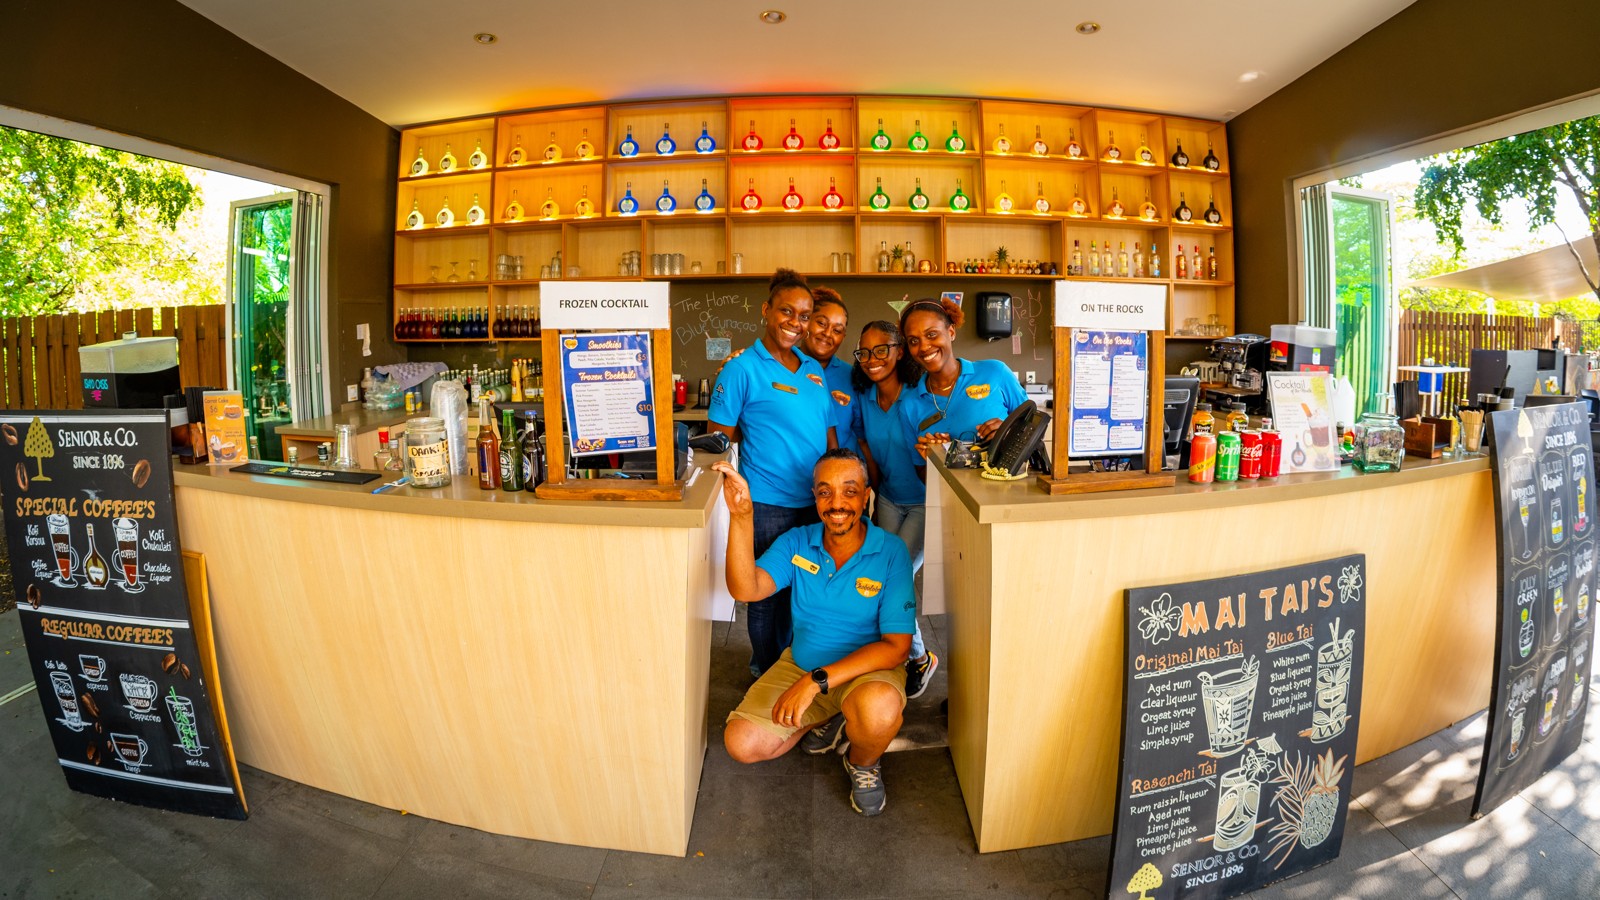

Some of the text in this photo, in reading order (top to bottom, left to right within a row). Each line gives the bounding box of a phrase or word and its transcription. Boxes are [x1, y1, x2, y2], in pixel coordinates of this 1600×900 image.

[559, 299, 649, 309] FROZEN COCKTAIL
[674, 291, 741, 312] The Home
[1081, 304, 1144, 314] ON THE ROCKS
[676, 321, 706, 345] Blue
[1114, 336, 1132, 346] Rocks
[588, 340, 622, 350] Smoothies
[578, 370, 636, 381] Frozen Cocktails
[1274, 380, 1306, 389] Cocktail
[58, 427, 138, 447] SENIOR & CO.
[1545, 434, 1564, 449] SINCE
[73, 454, 124, 470] SINCE 1896
[16, 497, 155, 519] SPECIAL COFFEE'S
[149, 529, 164, 541] Kofi
[144, 562, 171, 573] Chocolate
[1519, 574, 1536, 594] JOLLY
[1178, 575, 1334, 637] MAI TAI'S
[1517, 588, 1538, 606] GREEN
[41, 618, 174, 645] REGULAR COFFEE'S
[1266, 624, 1314, 649] Blue Tai
[1135, 638, 1243, 672] Original Mai Tai
[1272, 652, 1310, 670] White rum
[1270, 664, 1312, 683] Blue liqueur
[1147, 679, 1192, 695] Aged rum
[1269, 677, 1312, 697] Orgeat syrup
[1140, 692, 1197, 710] Clear liqueur
[1272, 690, 1307, 708] Lime juice
[1141, 706, 1196, 725] Orgeat syrup
[1262, 700, 1313, 722] Pineapple juice
[1146, 719, 1190, 735] Lime juice
[1140, 732, 1194, 751] Simple syrup
[1132, 760, 1217, 794] Rasenchi Tai
[1130, 804, 1152, 816] Rum
[1179, 788, 1209, 803] liqueur
[1148, 806, 1191, 823] Aged rum
[1147, 816, 1190, 836] Lime juice
[1136, 825, 1198, 848] Pineapple juice
[1141, 837, 1192, 858] Orange juice
[1170, 844, 1260, 878] SENIOR & CO.
[1185, 863, 1244, 889] SINCE 1896
